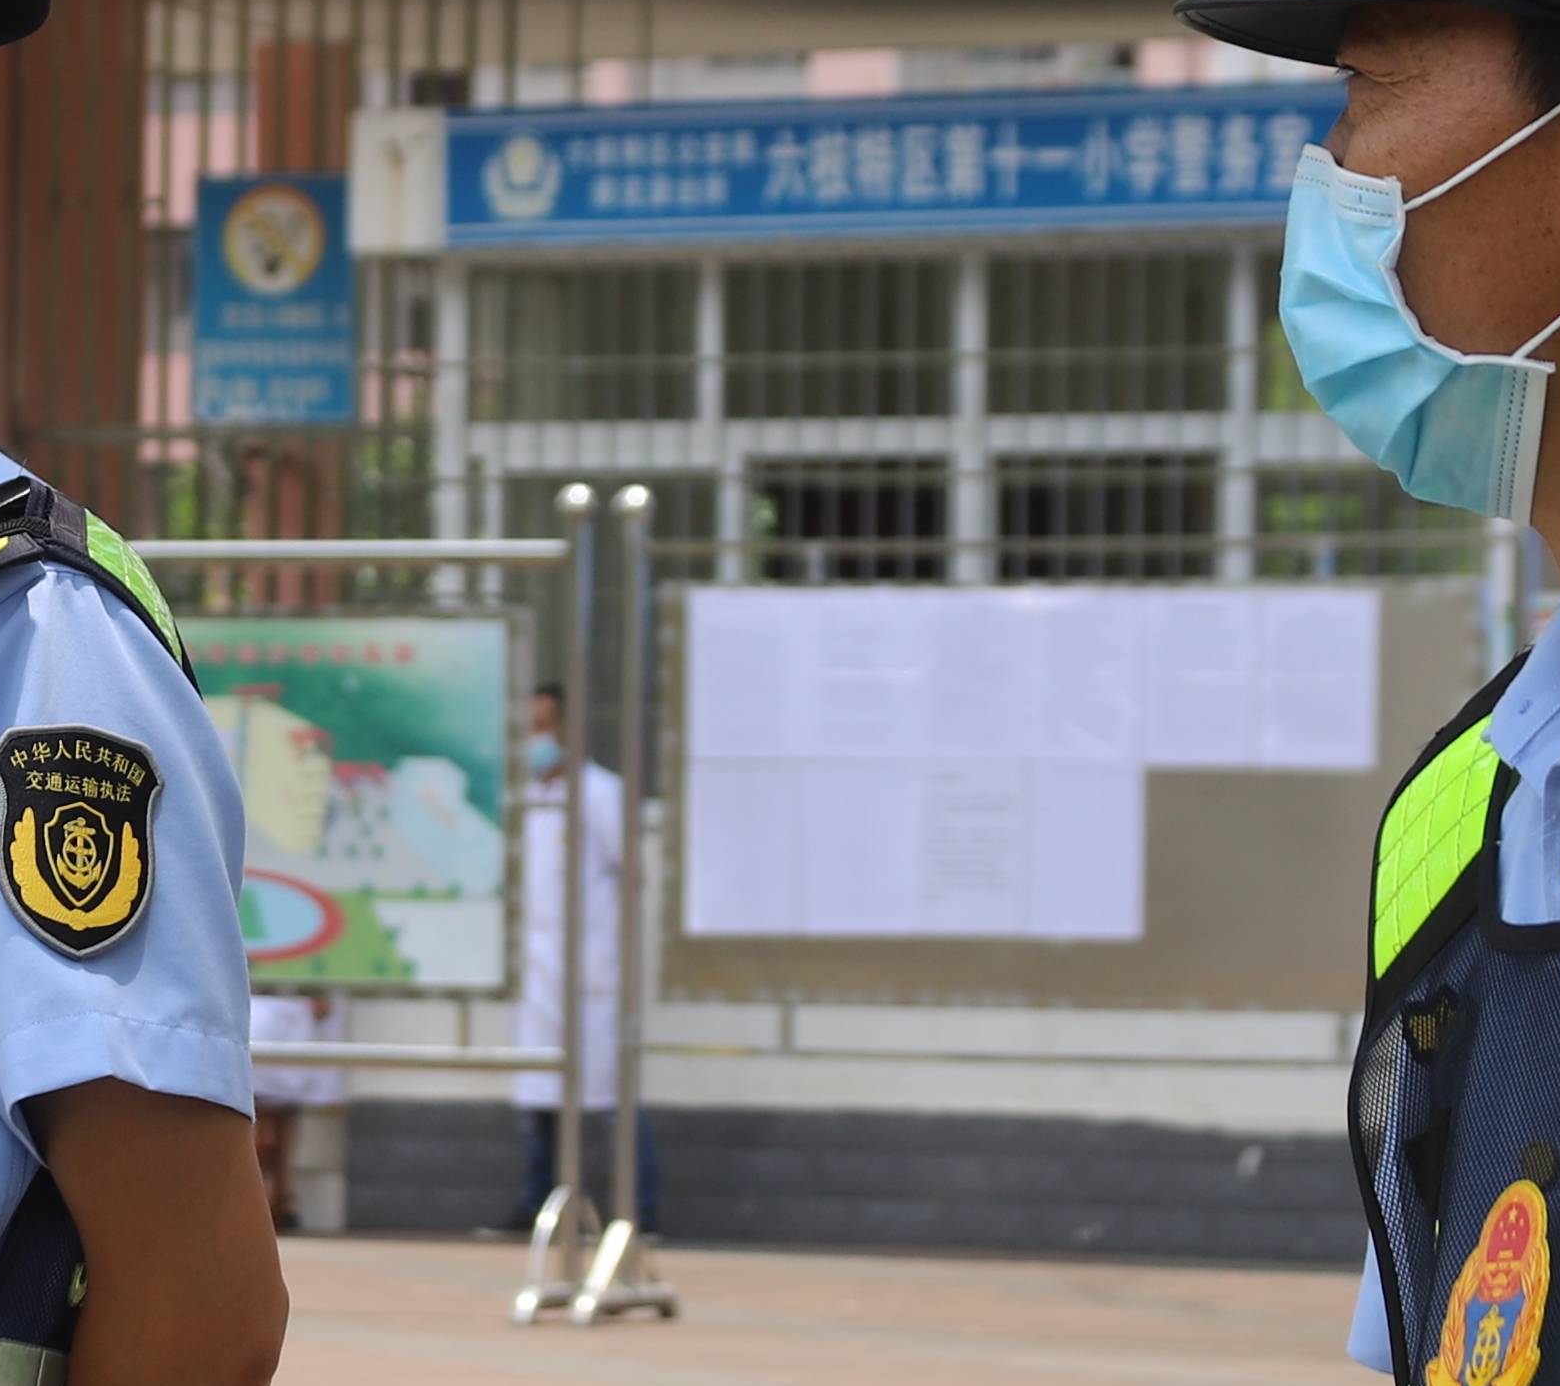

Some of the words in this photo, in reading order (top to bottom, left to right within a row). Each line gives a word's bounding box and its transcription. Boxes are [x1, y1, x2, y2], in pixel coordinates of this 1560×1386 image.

[10, 739, 146, 787] 中华人民共和国
[25, 770, 132, 802] 交通运输执法
